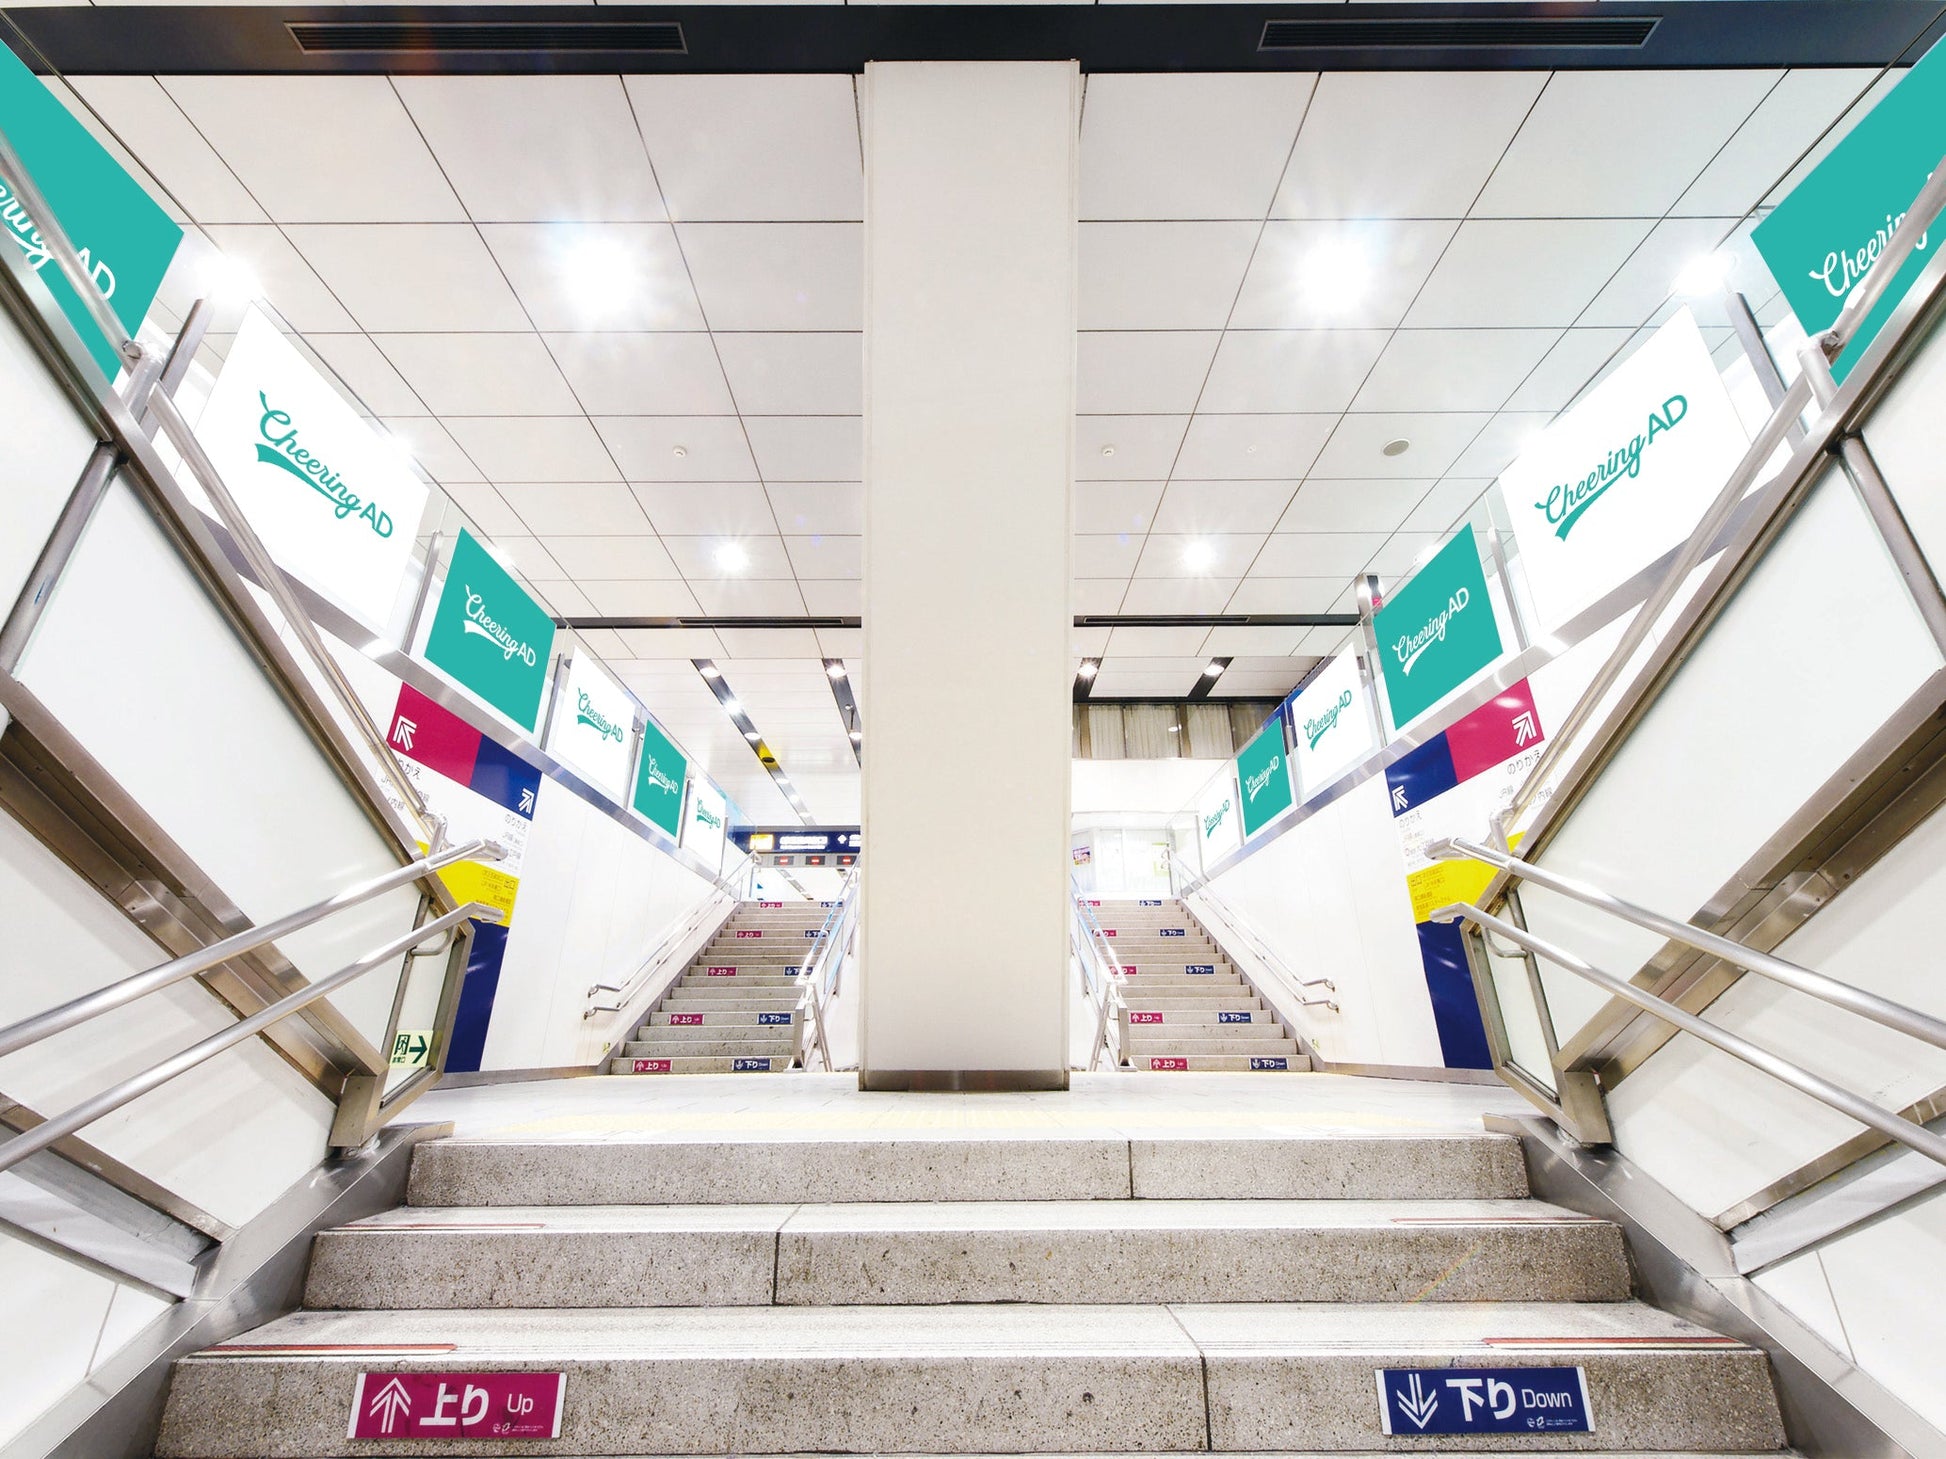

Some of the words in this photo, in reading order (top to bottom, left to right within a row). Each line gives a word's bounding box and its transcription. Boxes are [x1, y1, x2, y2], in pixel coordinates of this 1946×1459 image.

[257, 390, 363, 520] Cheering
[358, 501, 394, 539] AD
[1534, 434, 1647, 525] Cheering
[1648, 394, 1688, 446] AD
[464, 583, 519, 660] Cheering
[516, 641, 537, 667] AD
[1391, 609, 1449, 664] Cheering
[1448, 586, 1470, 620] AD
[577, 687, 611, 741] Cheering
[610, 723, 624, 743] AD
[1303, 706, 1339, 741] Cheering
[1338, 689, 1353, 714] AD
[419, 1382, 490, 1426] 上り
[507, 1393, 533, 1415] Up
[1445, 1378, 1517, 1422] 下り
[1521, 1389, 1573, 1408] Down
